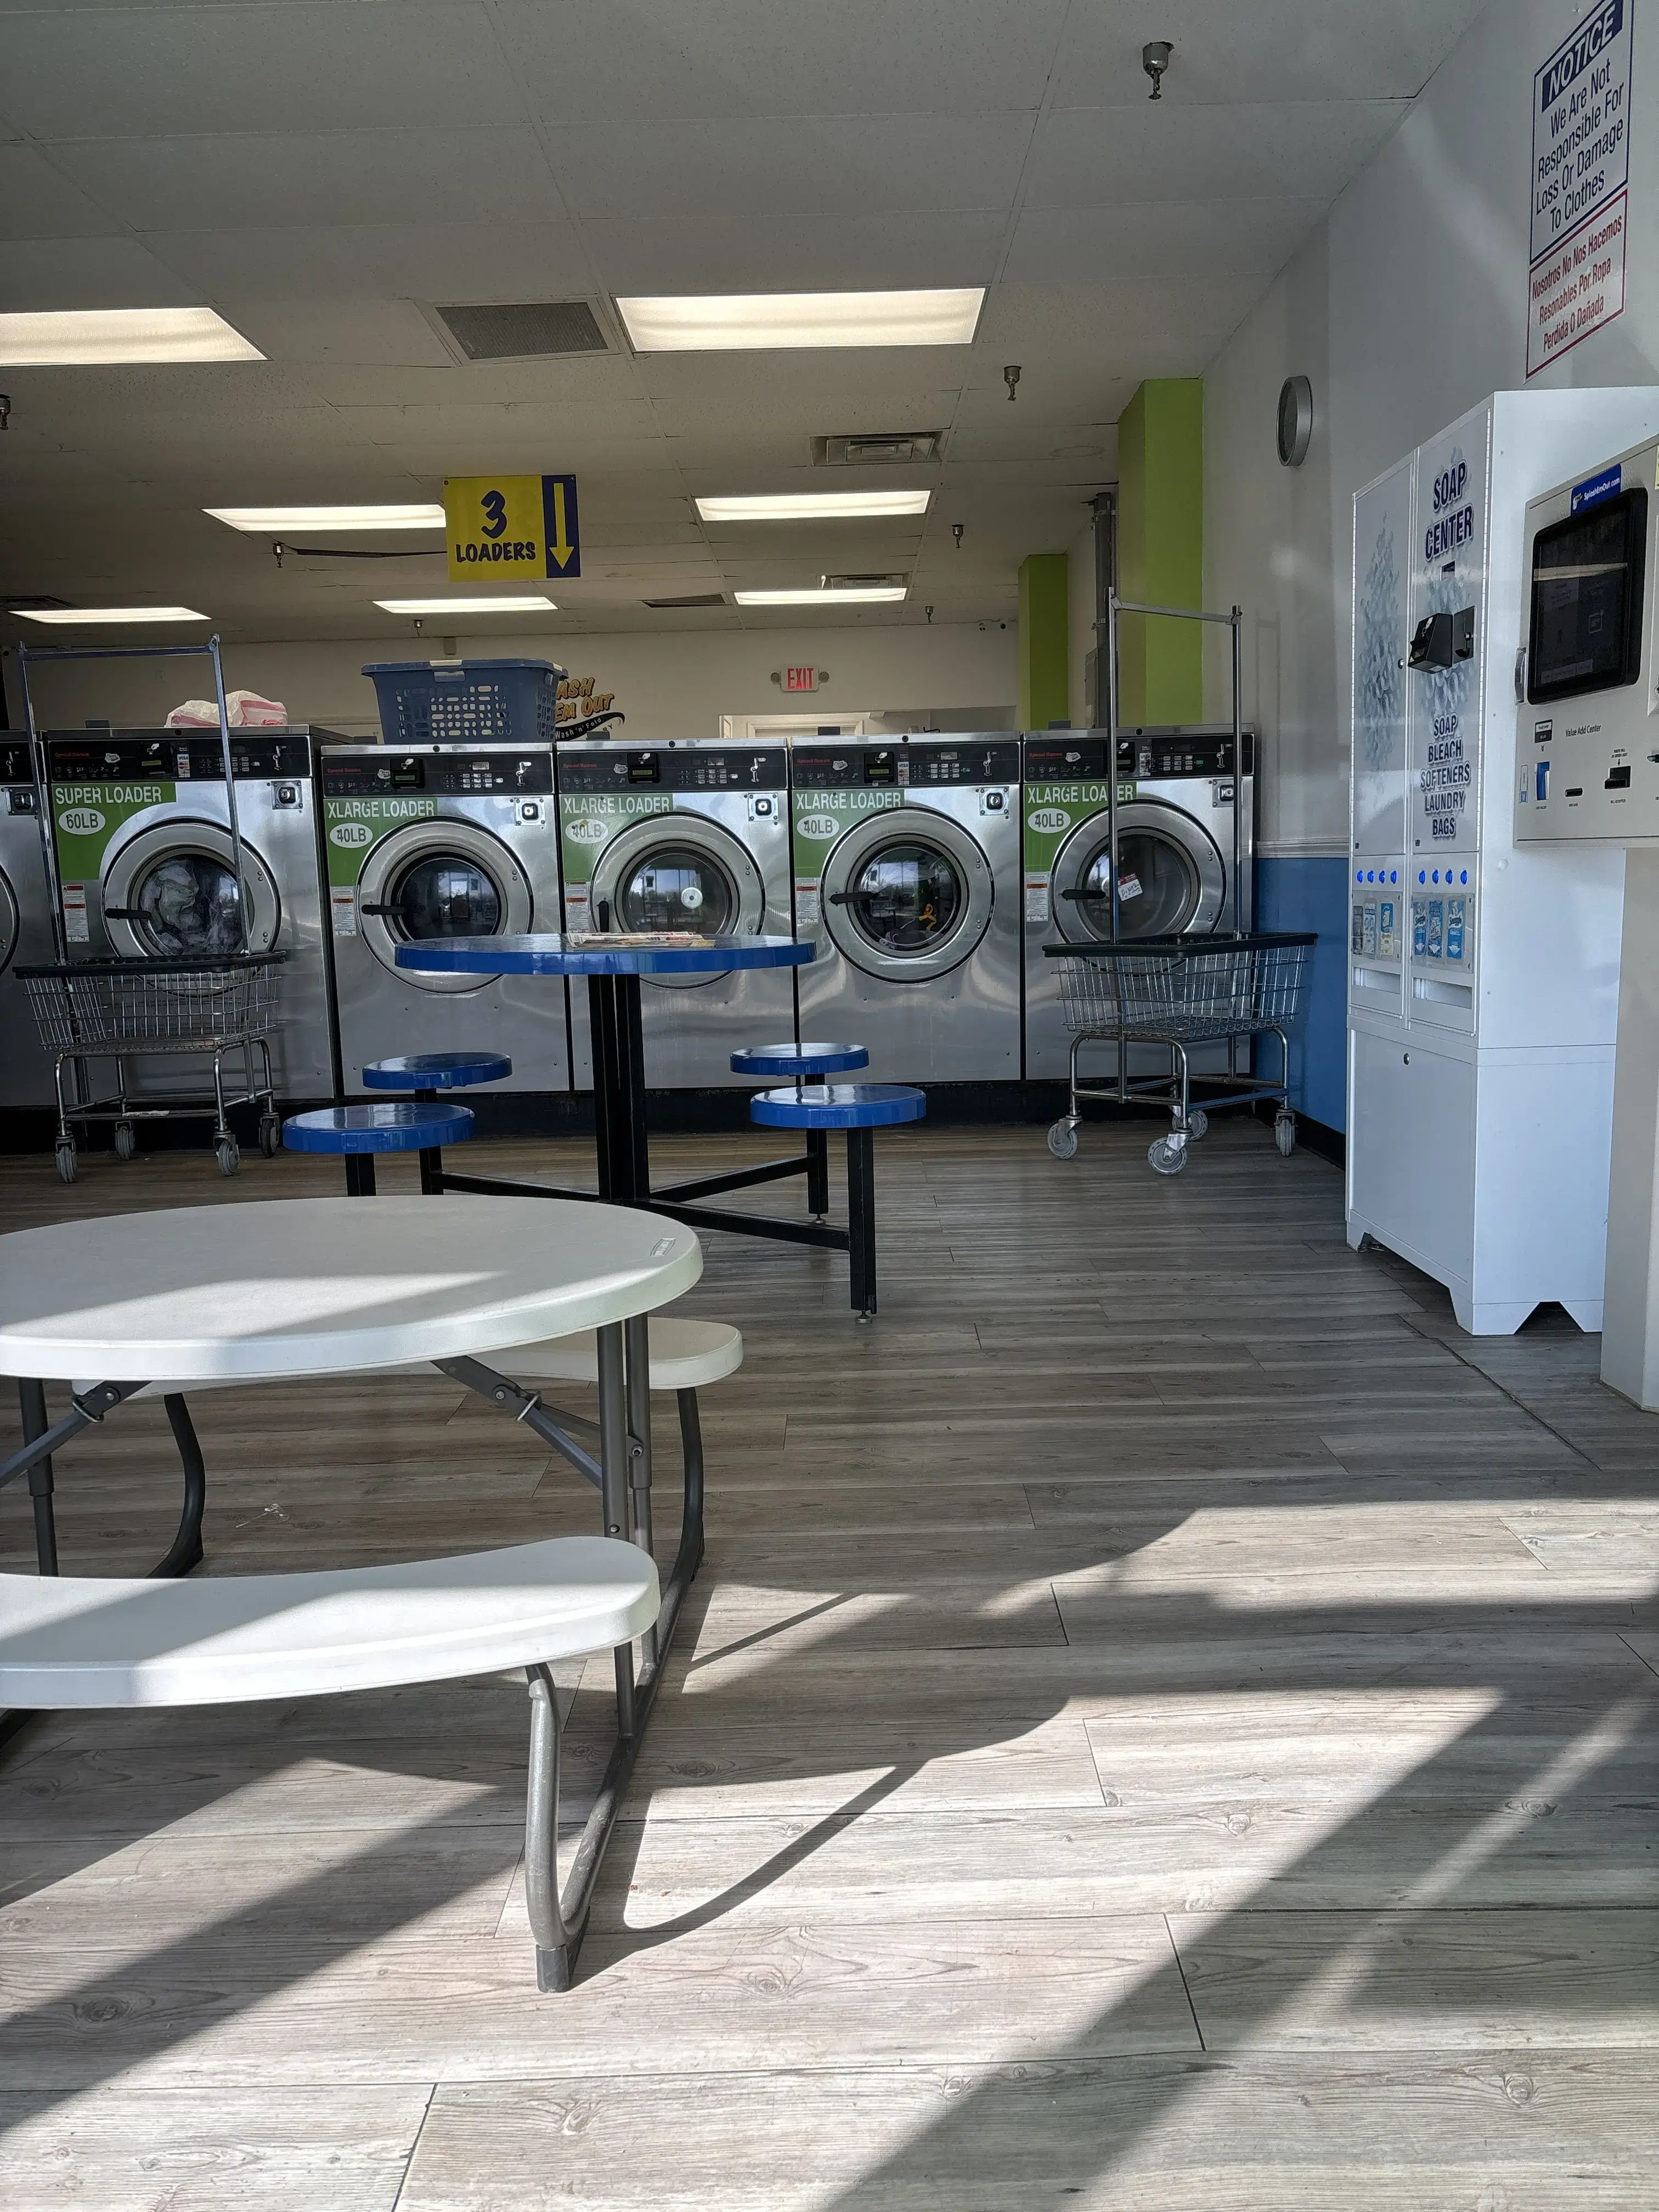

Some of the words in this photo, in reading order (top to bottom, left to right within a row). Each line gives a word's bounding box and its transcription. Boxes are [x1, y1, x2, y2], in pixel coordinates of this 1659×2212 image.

[1548, 3, 1616, 104] NOTICE
[1551, 108, 1566, 138] We
[1568, 87, 1587, 122] Are
[1591, 58, 1611, 99] Not
[1538, 106, 1601, 183] Responsible
[1605, 82, 1624, 119] For
[1536, 179, 1559, 216] Loss
[1562, 163, 1575, 191] Or
[1577, 119, 1623, 178] Damage
[1550, 206, 1561, 233] To
[1565, 170, 1605, 221] Clothes
[1532, 265, 1561, 301] Nosotros
[1562, 255, 1571, 278] No
[1573, 245, 1587, 269] Nos
[1588, 215, 1622, 257] Hacemos
[1539, 284, 1577, 326] Resonables
[1579, 270, 1592, 296] Por
[1593, 257, 1611, 286] Ropa
[1543, 320, 1568, 353] Perdida
[1570, 312, 1575, 334] O
[1577, 294, 1604, 329] Dañada
[1433, 461, 1467, 511] SOAP
[1584, 477, 1620, 501] SplashEmOut.com
[481, 490, 507, 539] 3
[1425, 505, 1473, 560] CENTER
[456, 541, 536, 563] LOADERS
[556, 677, 596, 701] ASH
[787, 667, 814, 690] EXIT
[581, 693, 615, 717] OUT
[555, 729, 574, 740] Wash
[586, 717, 602, 729] Fold
[1434, 714, 1457, 737] SOAP
[1566, 727, 1577, 737] Value
[1577, 725, 1587, 735] Add
[1587, 724, 1601, 733] Center
[1427, 738, 1463, 763] BLEACH
[1420, 763, 1470, 789] SOFTENERS
[55, 787, 102, 804] SUPER
[105, 786, 162, 804] LOADER
[563, 797, 616, 814] XLARGE
[618, 797, 670, 813] LOADER
[796, 793, 847, 810] XLARGE
[850, 792, 901, 809] LOADER
[1028, 787, 1079, 804] XLARGE
[1082, 785, 1133, 802] LOAER
[1425, 790, 1465, 812] LAUNDRY
[66, 812, 99, 829] 60LB
[328, 802, 380, 818] XLARGE
[382, 800, 435, 817] LOADER
[1035, 813, 1065, 828] 40LB
[337, 828, 366, 843] 40LB
[572, 824, 602, 838] 40LB
[804, 820, 833, 834] 40LB
[1432, 817, 1455, 836] BAGS
